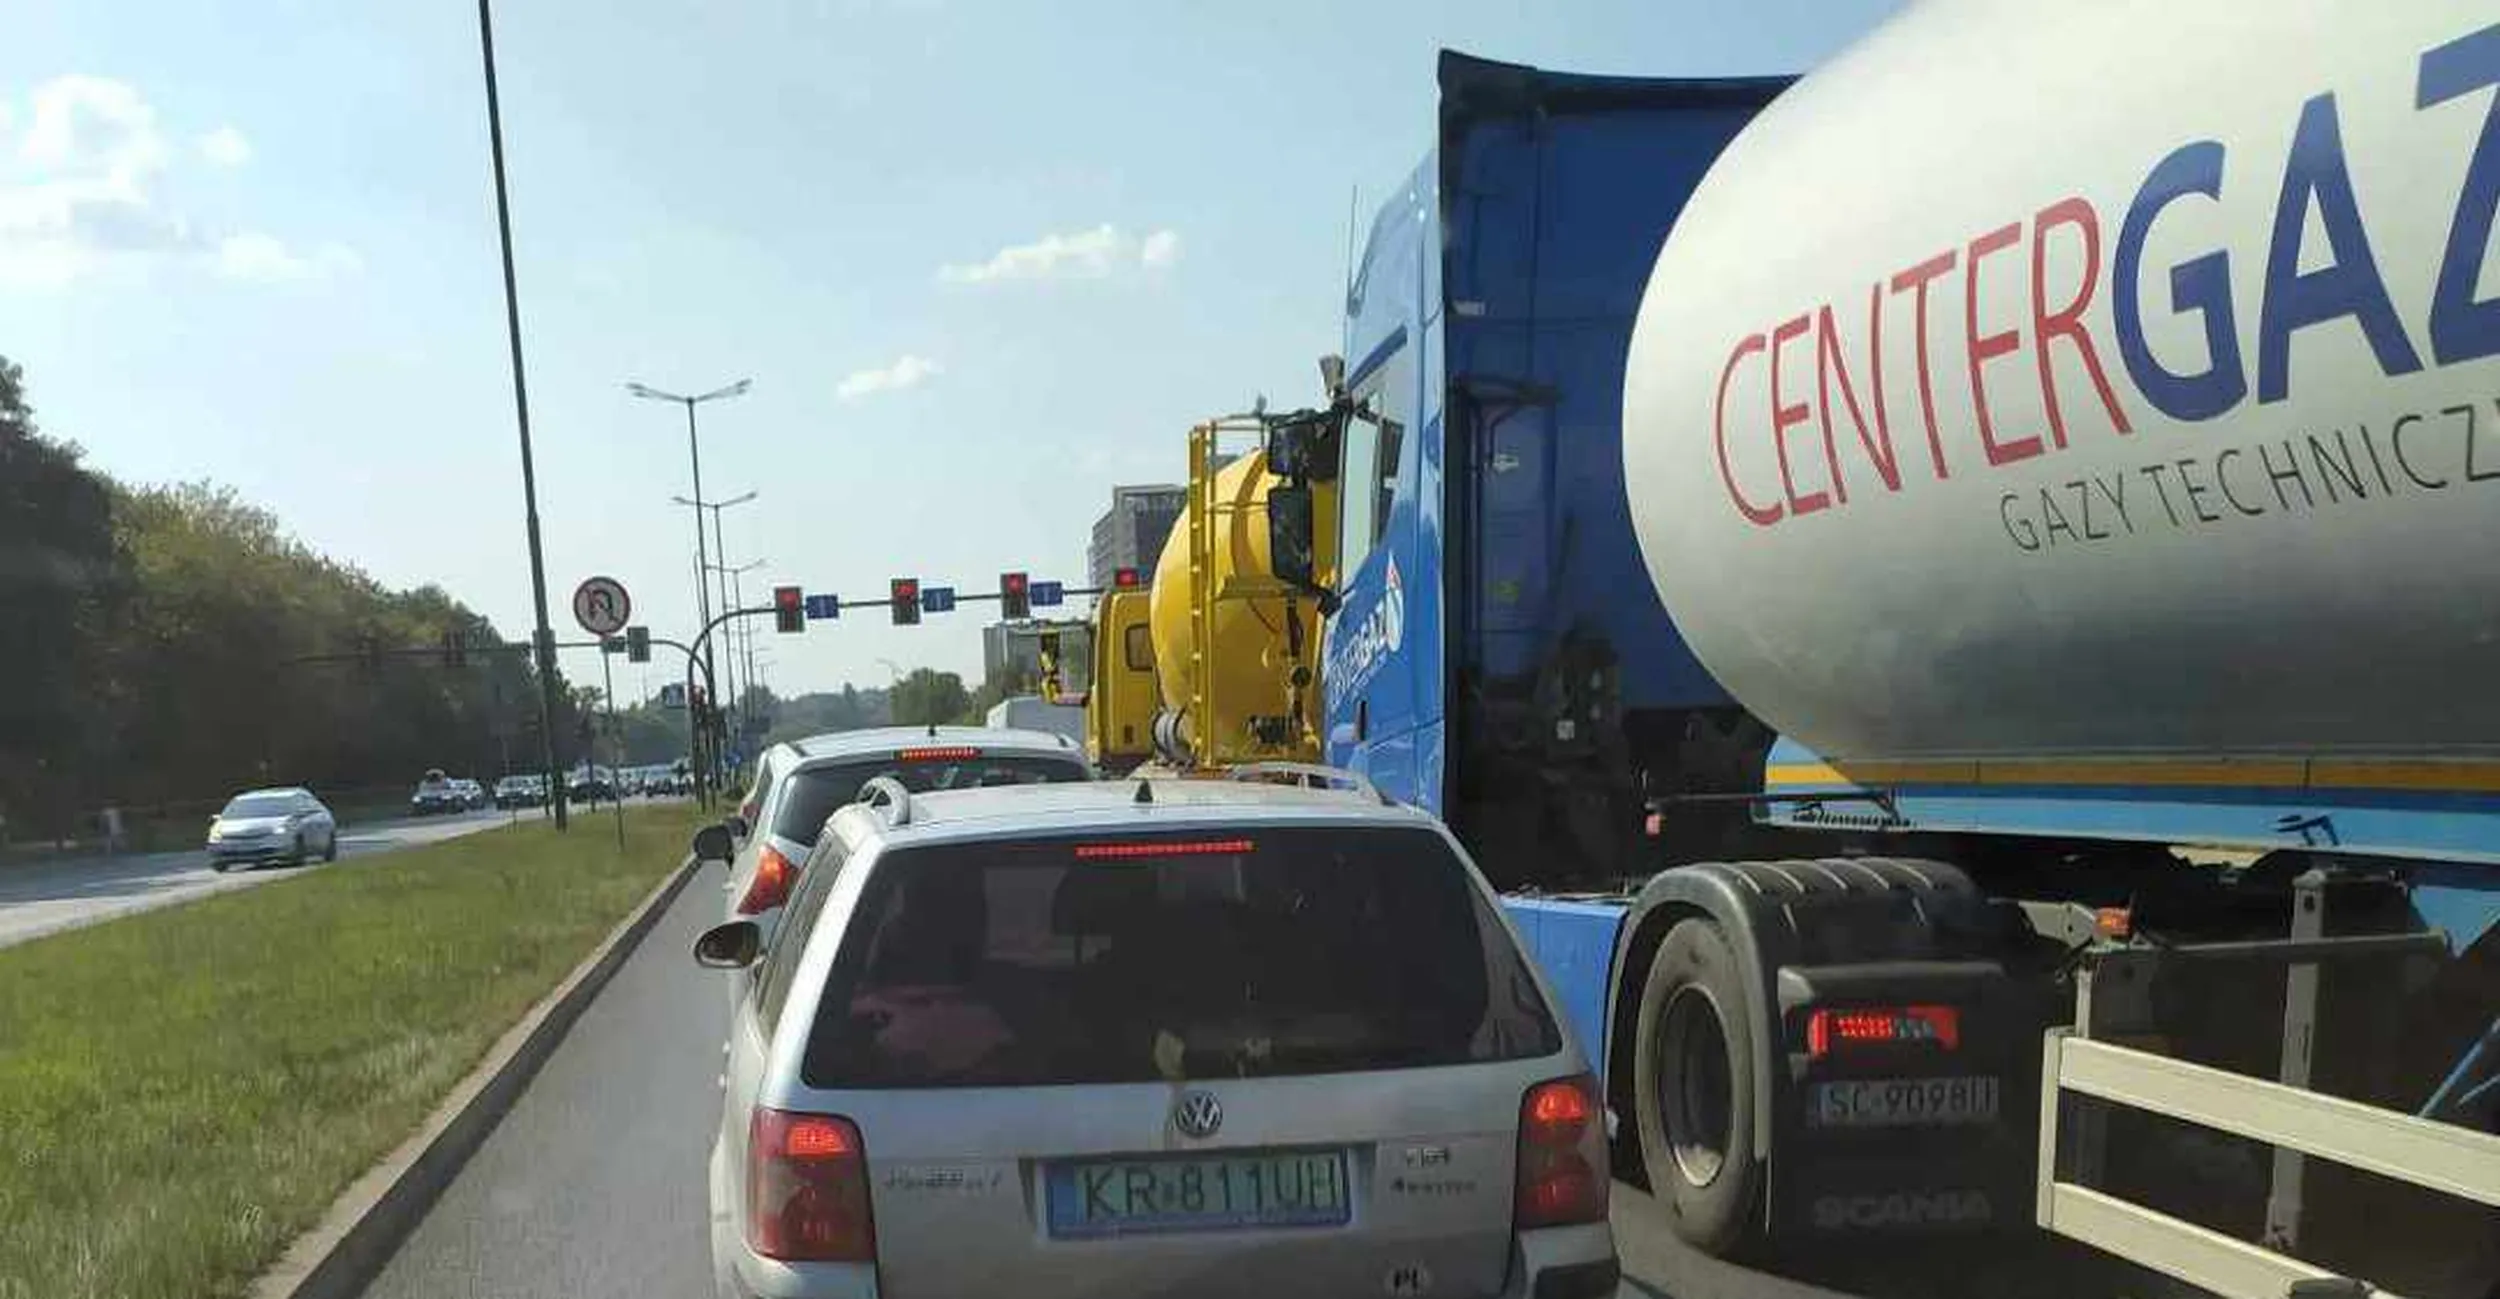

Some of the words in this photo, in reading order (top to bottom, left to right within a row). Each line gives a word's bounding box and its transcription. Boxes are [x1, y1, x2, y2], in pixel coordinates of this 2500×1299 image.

[1716, 22, 2500, 526] CENTERGAZ
[2000, 472, 2134, 551] GAZY
[2140, 398, 2500, 527] TECHNICZ
[1829, 1084, 1868, 1118] SC
[1084, 1166, 1158, 1221] KR
